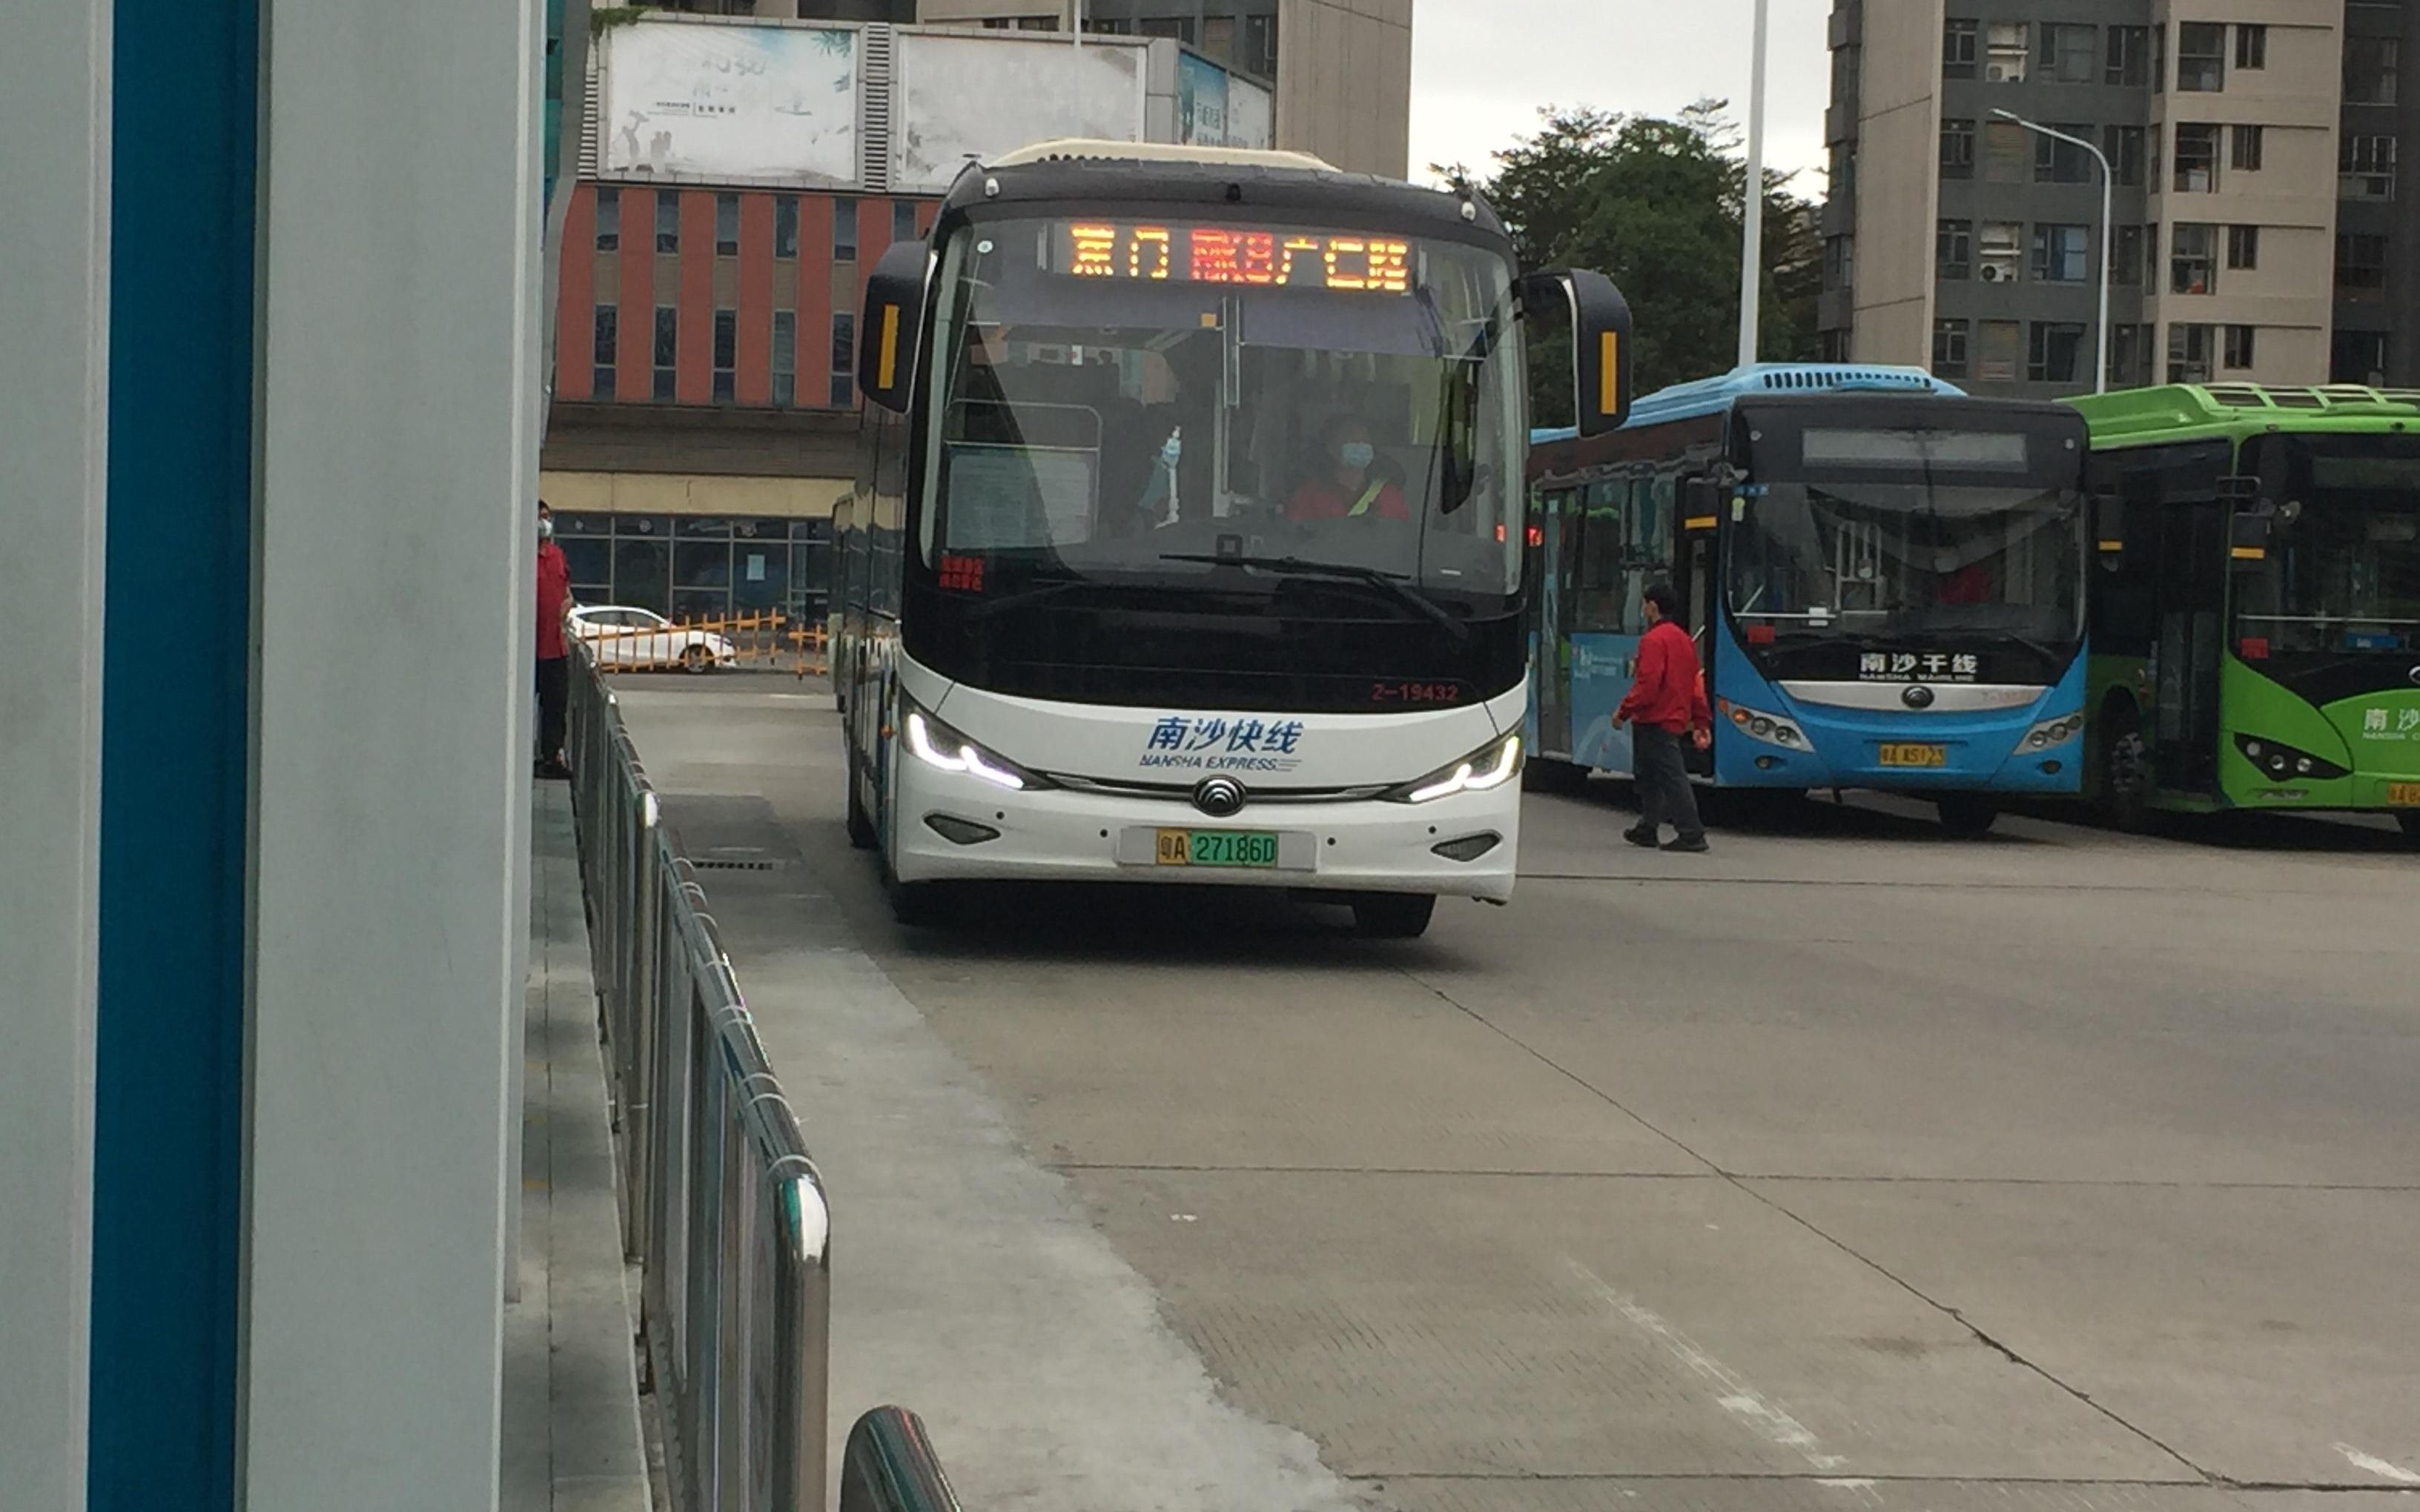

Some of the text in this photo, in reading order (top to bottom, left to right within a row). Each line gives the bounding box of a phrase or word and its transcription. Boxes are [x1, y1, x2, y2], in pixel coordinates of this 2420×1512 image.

[1859, 652, 1977, 674] 南沙干线
[1148, 717, 1303, 754] 南沙快线
[1140, 754, 1277, 772] NANSHA EXPRESS
